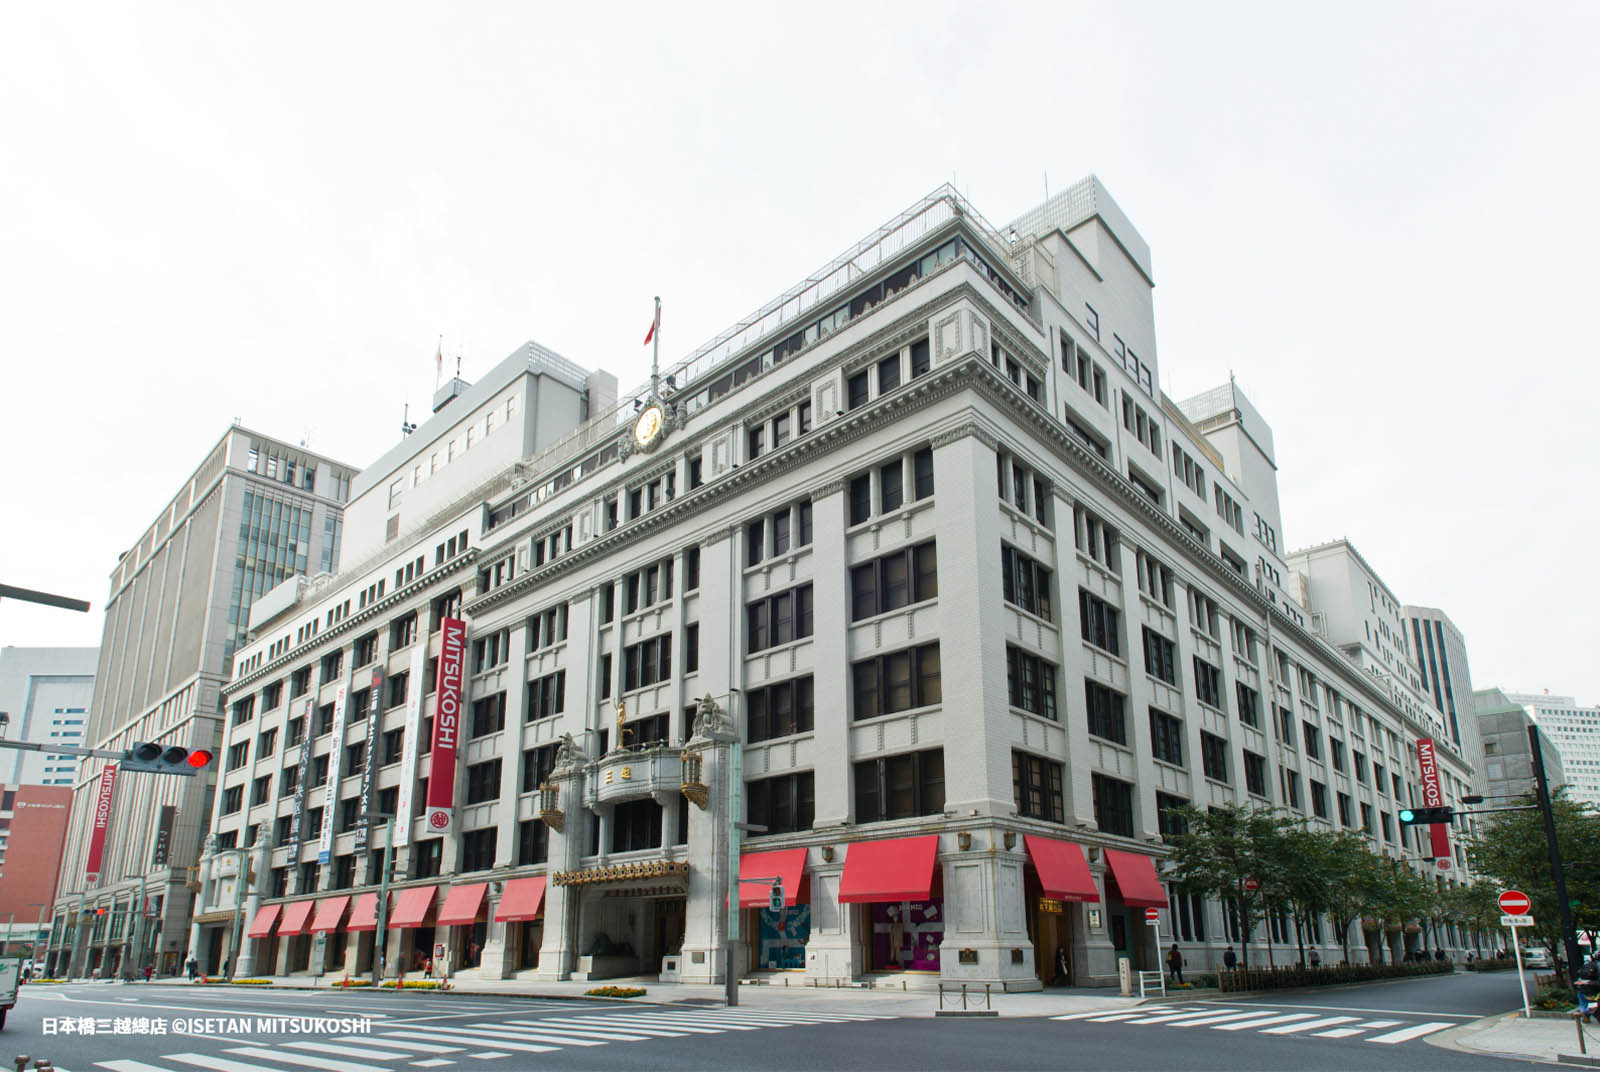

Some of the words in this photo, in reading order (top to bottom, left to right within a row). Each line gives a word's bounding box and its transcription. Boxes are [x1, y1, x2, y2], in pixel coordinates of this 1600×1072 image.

[438, 626, 462, 749] MITSUKOSHI
[96, 769, 114, 828] MITSUKOSHI
[1420, 744, 1440, 807] MITSUKOS
